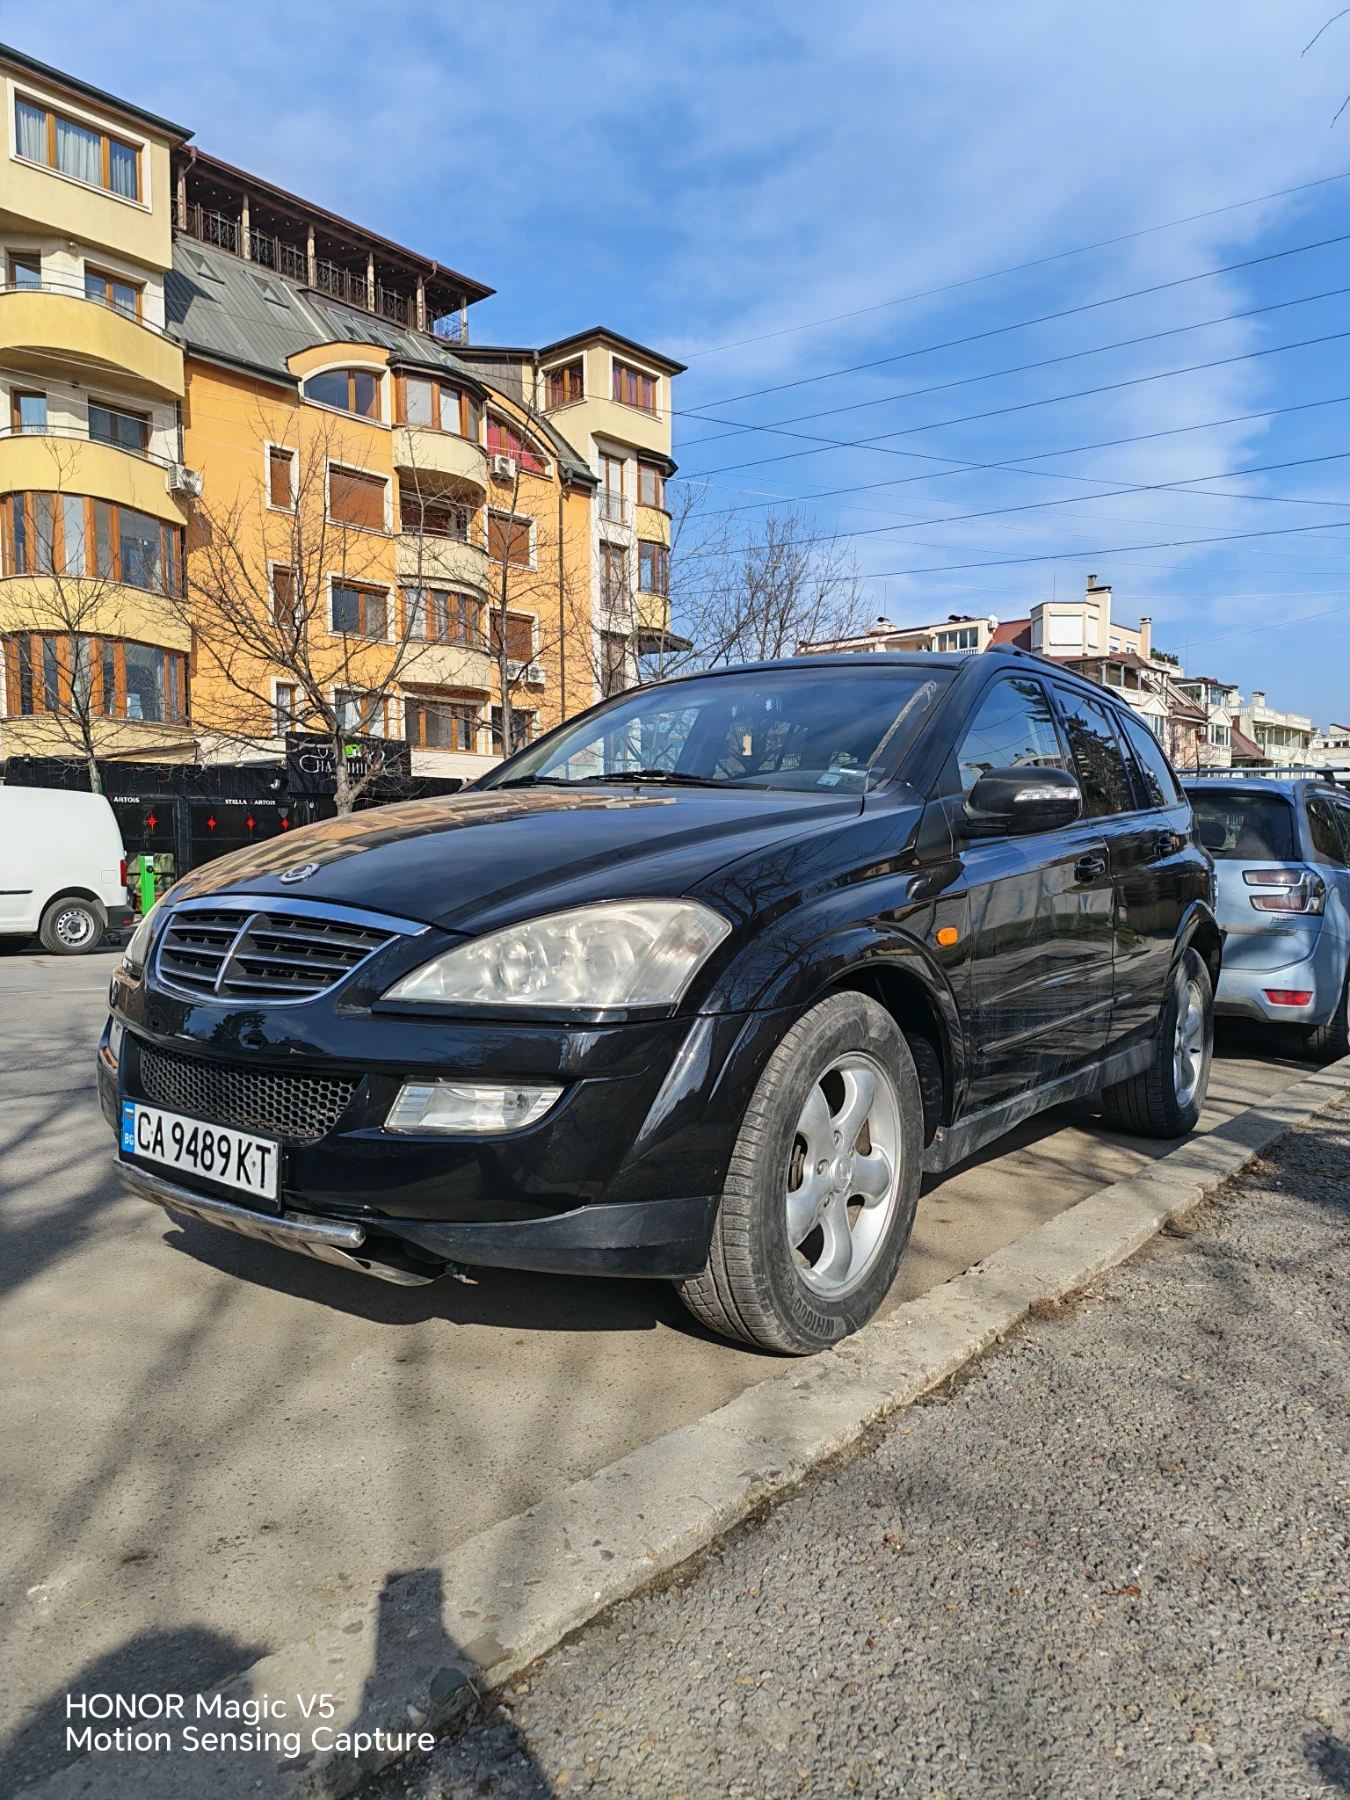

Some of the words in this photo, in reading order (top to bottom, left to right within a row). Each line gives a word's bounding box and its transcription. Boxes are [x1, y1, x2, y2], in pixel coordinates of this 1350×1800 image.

[113, 796, 140, 804] ARTOIS
[124, 1132, 134, 1146] BG
[137, 1111, 165, 1158] CA
[171, 1121, 231, 1177] 9489
[236, 1138, 272, 1189] KT
